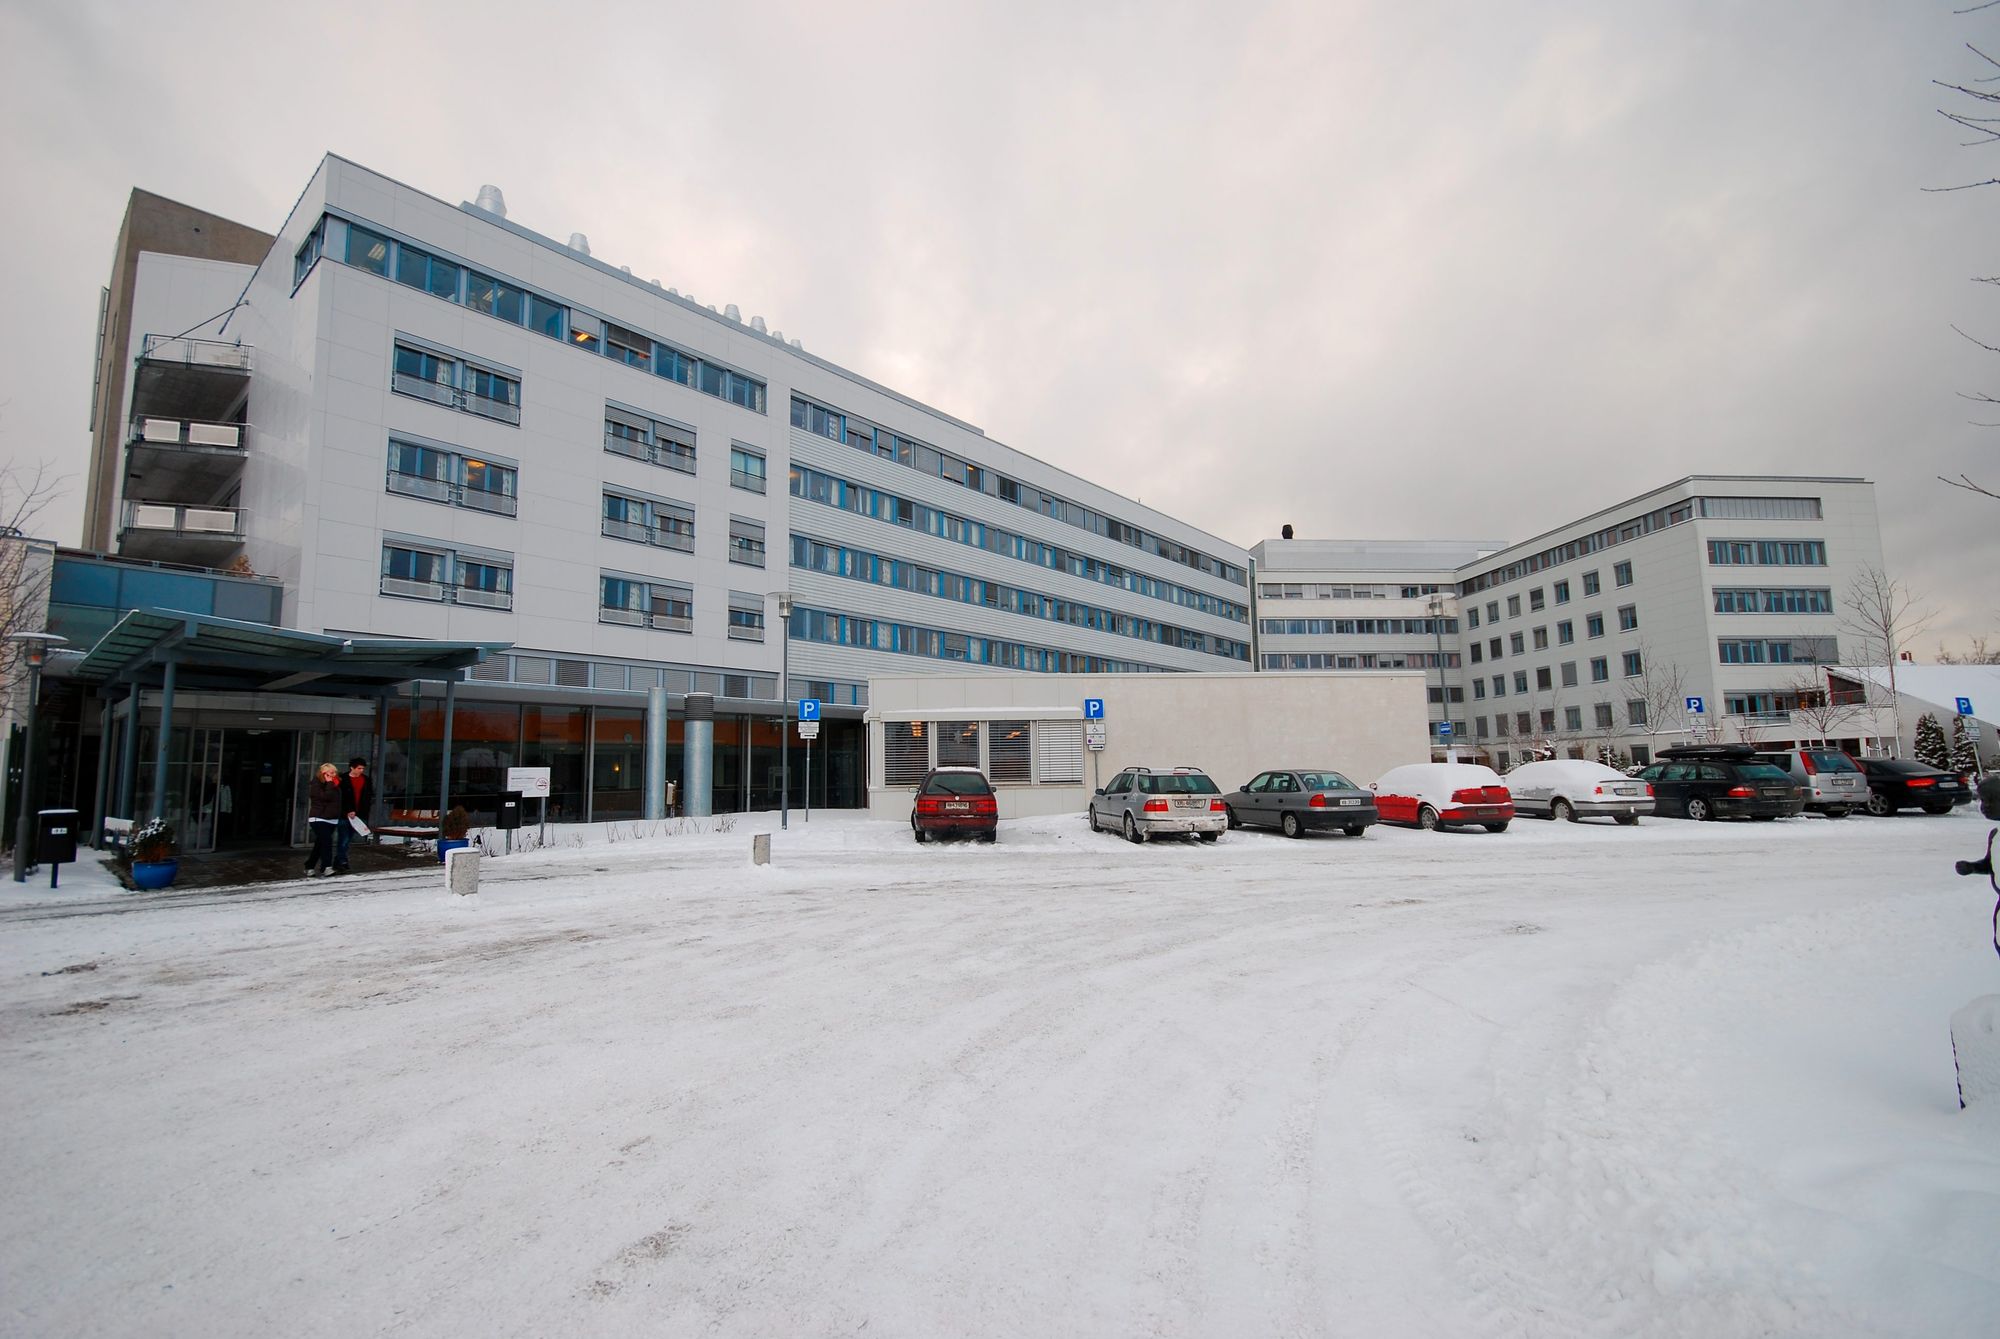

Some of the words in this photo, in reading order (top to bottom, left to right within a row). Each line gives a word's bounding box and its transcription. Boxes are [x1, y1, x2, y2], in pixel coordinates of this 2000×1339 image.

[804, 702, 814, 717] P
[1089, 701, 1099, 716] P
[1690, 699, 1699, 711] P
[1959, 699, 1968, 713] P
